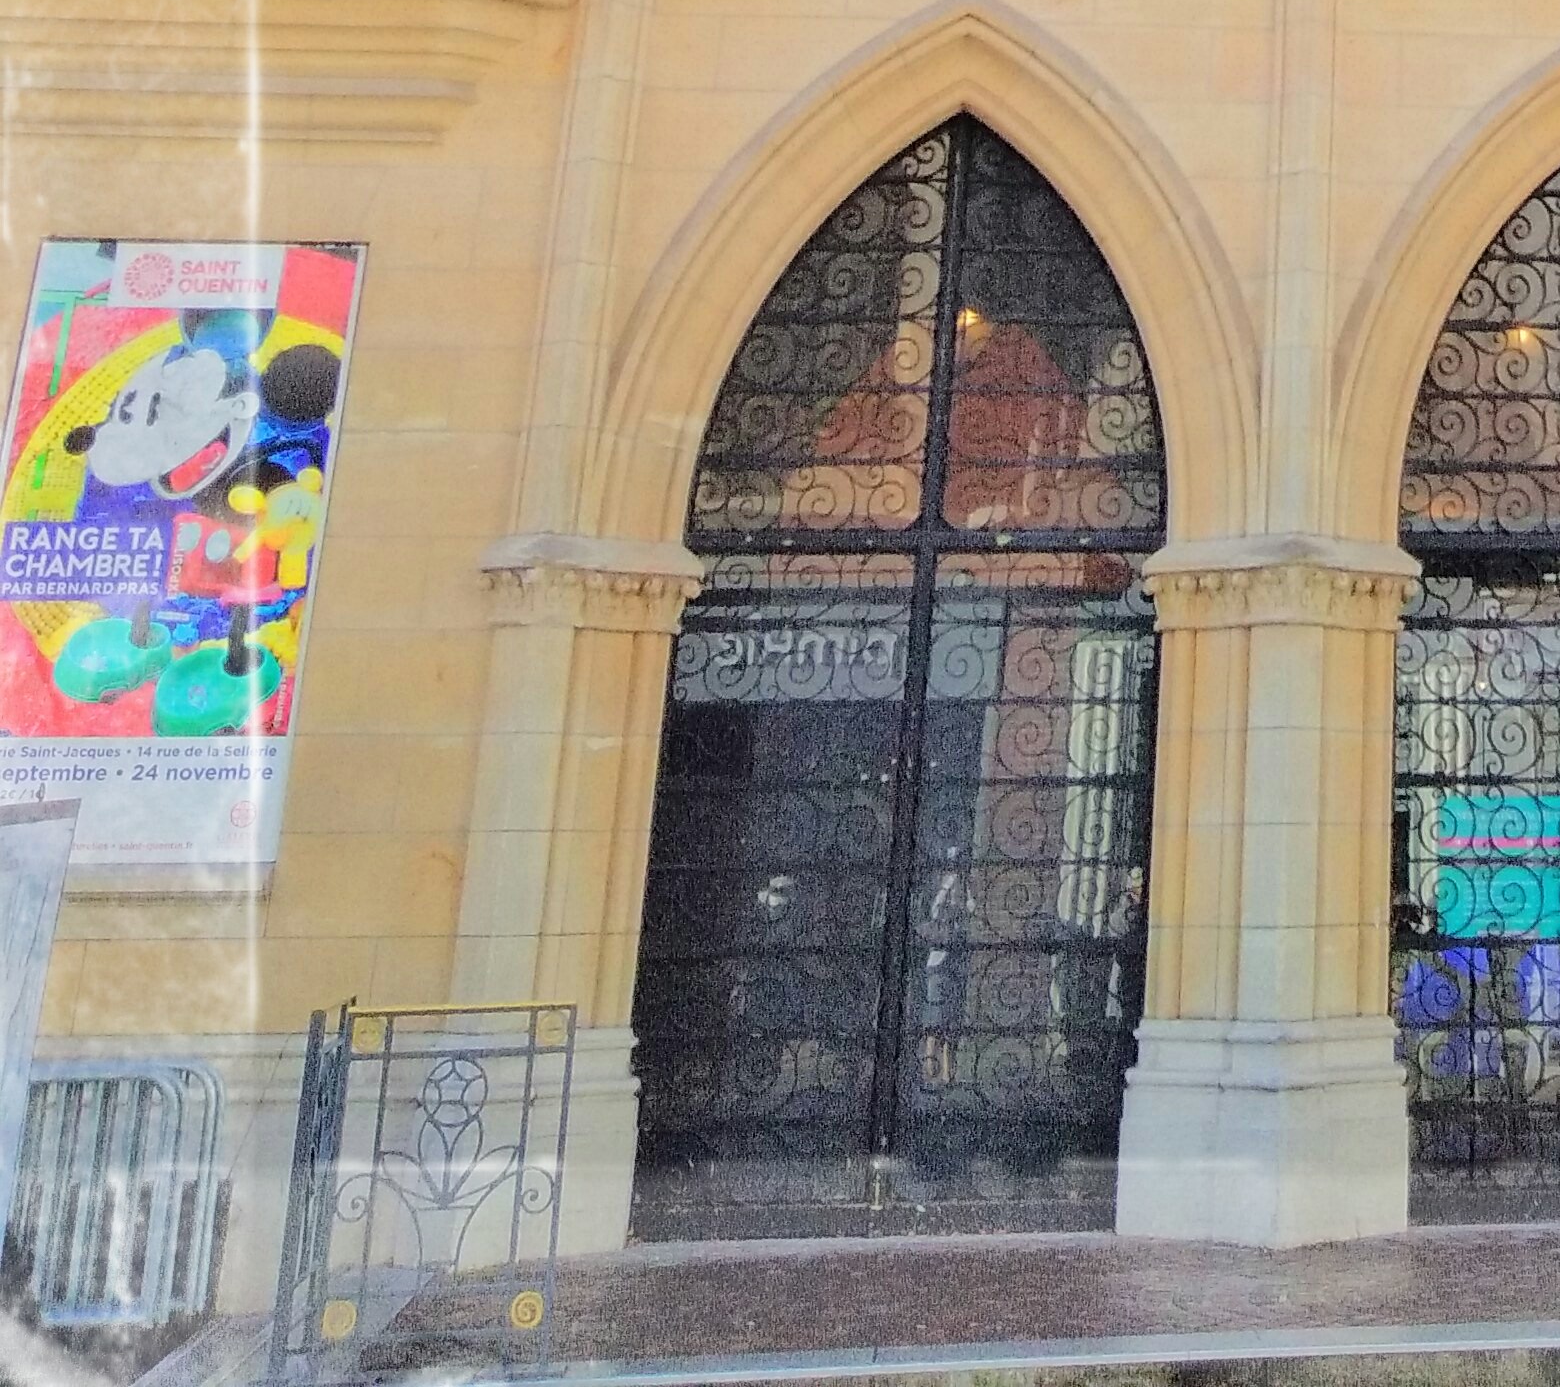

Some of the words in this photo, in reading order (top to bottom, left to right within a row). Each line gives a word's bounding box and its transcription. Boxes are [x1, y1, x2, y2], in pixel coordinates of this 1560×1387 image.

[181, 260, 241, 275] SAINT
[178, 278, 268, 294] QUENTIN
[9, 526, 119, 551] RANGE
[129, 526, 164, 551] TA
[1, 582, 33, 595] PAR
[36, 582, 114, 595] BERNARD
[117, 582, 160, 595] PRAS
[20, 746, 121, 759] Saint-Jacques
[138, 746, 152, 757] 14
[157, 747, 180, 757] rue
[184, 746, 203, 757] de
[207, 746, 219, 757] la
[131, 764, 158, 781] 24
